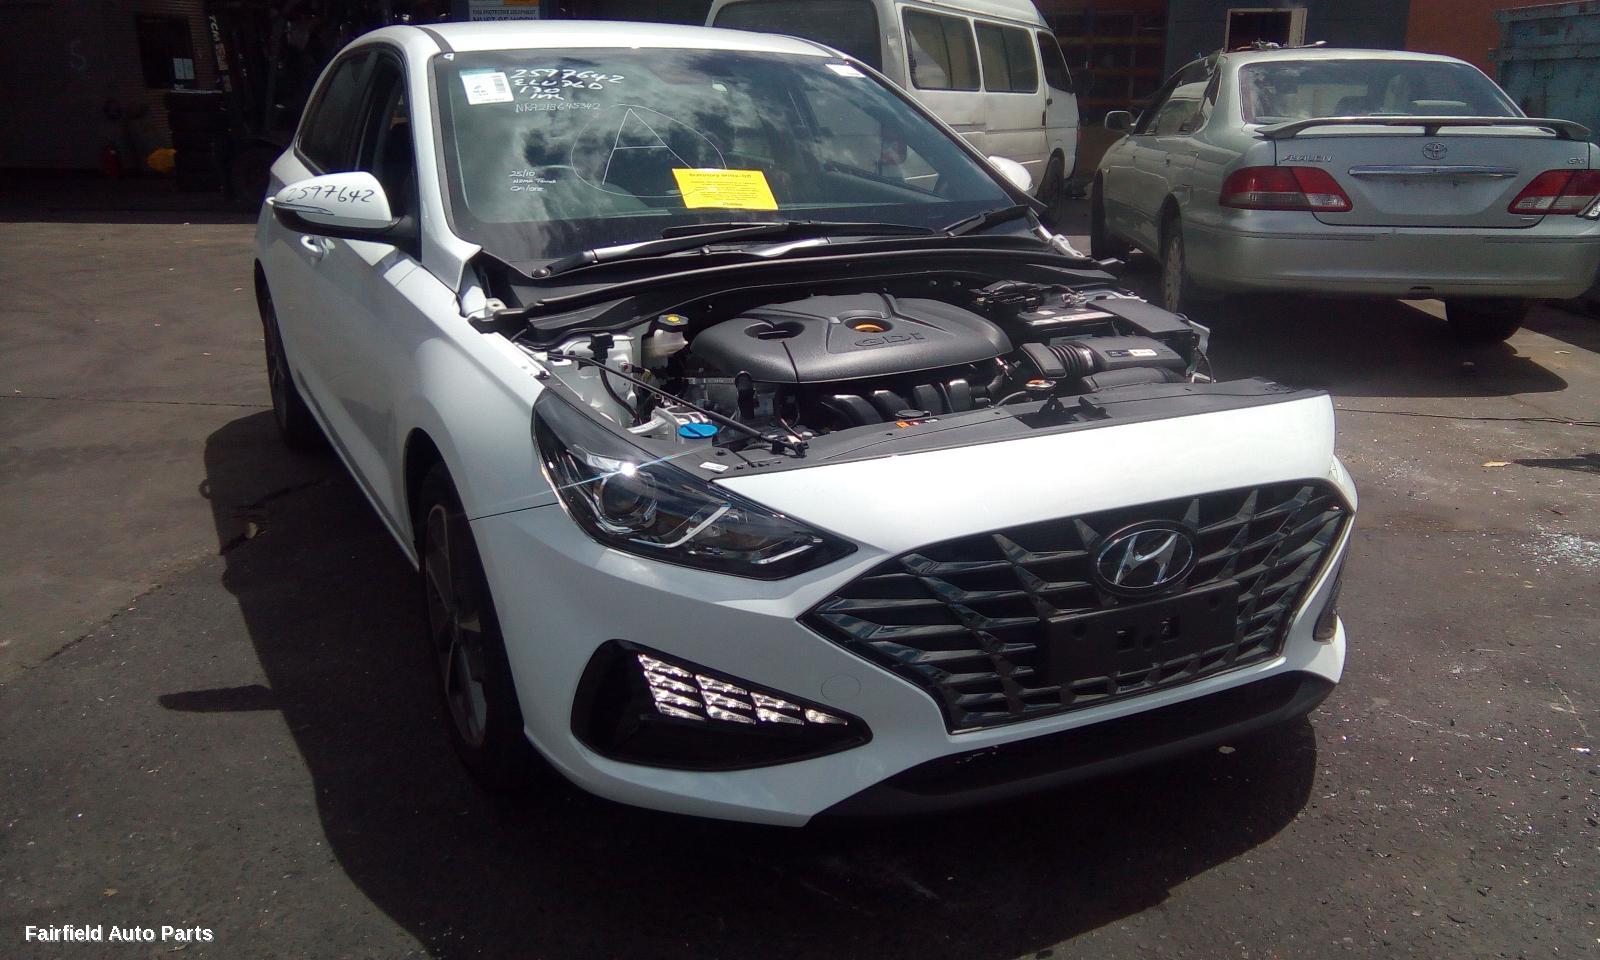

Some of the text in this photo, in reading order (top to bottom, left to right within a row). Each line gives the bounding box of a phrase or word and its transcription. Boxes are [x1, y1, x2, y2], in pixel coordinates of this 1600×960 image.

[511, 68, 624, 83] 2597642
[286, 185, 375, 203] 2597642
[855, 333, 926, 347] GDI
